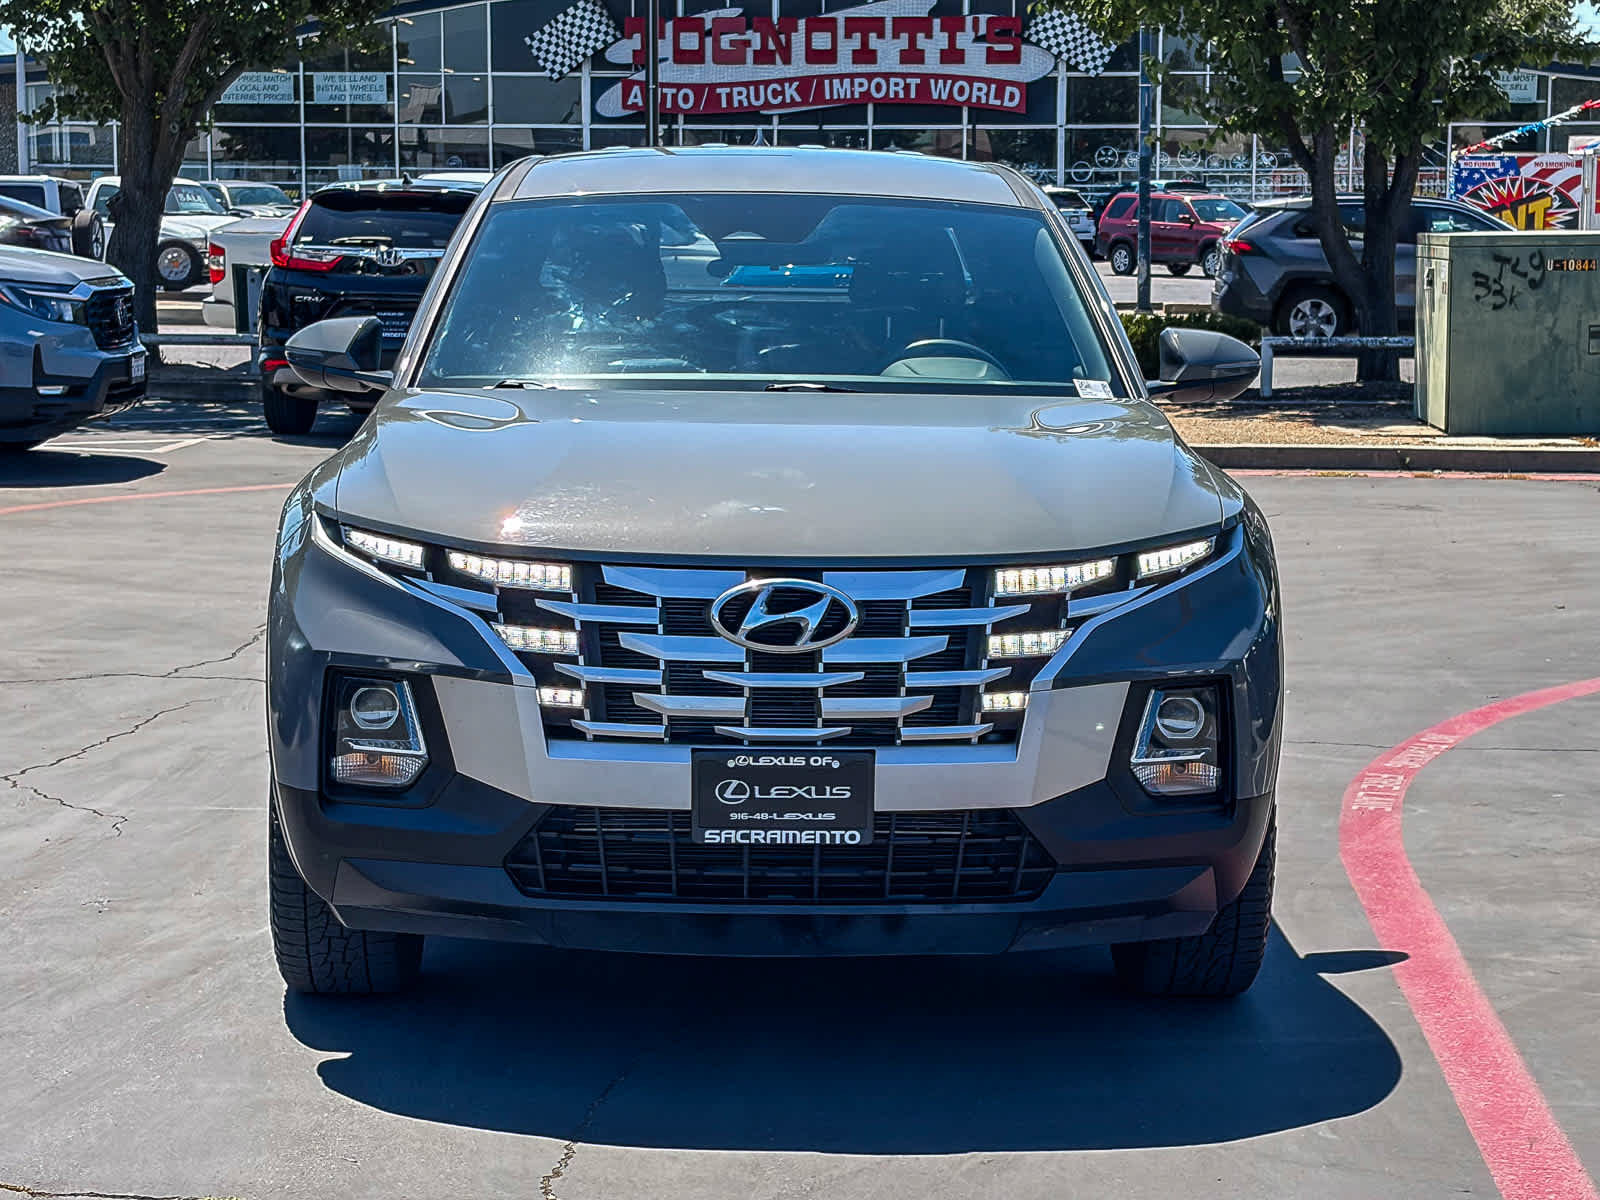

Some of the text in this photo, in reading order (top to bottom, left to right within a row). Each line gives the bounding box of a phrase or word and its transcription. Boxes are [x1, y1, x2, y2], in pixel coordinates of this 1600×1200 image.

[624, 16, 1022, 65] TOGNOTTI'S
[316, 84, 384, 92] INSTALL WHEELS
[627, 85, 695, 109] ATO
[716, 81, 802, 108] TRUCK
[824, 77, 921, 100] IMPORT
[930, 79, 1021, 108] WORLD
[1545, 161, 1576, 169] SMOKING
[1546, 258, 1597, 272] U-10844
[751, 756, 833, 767] LEXUS OF
[754, 785, 852, 800] LEXUS
[704, 829, 862, 845] SACRAMENTO
